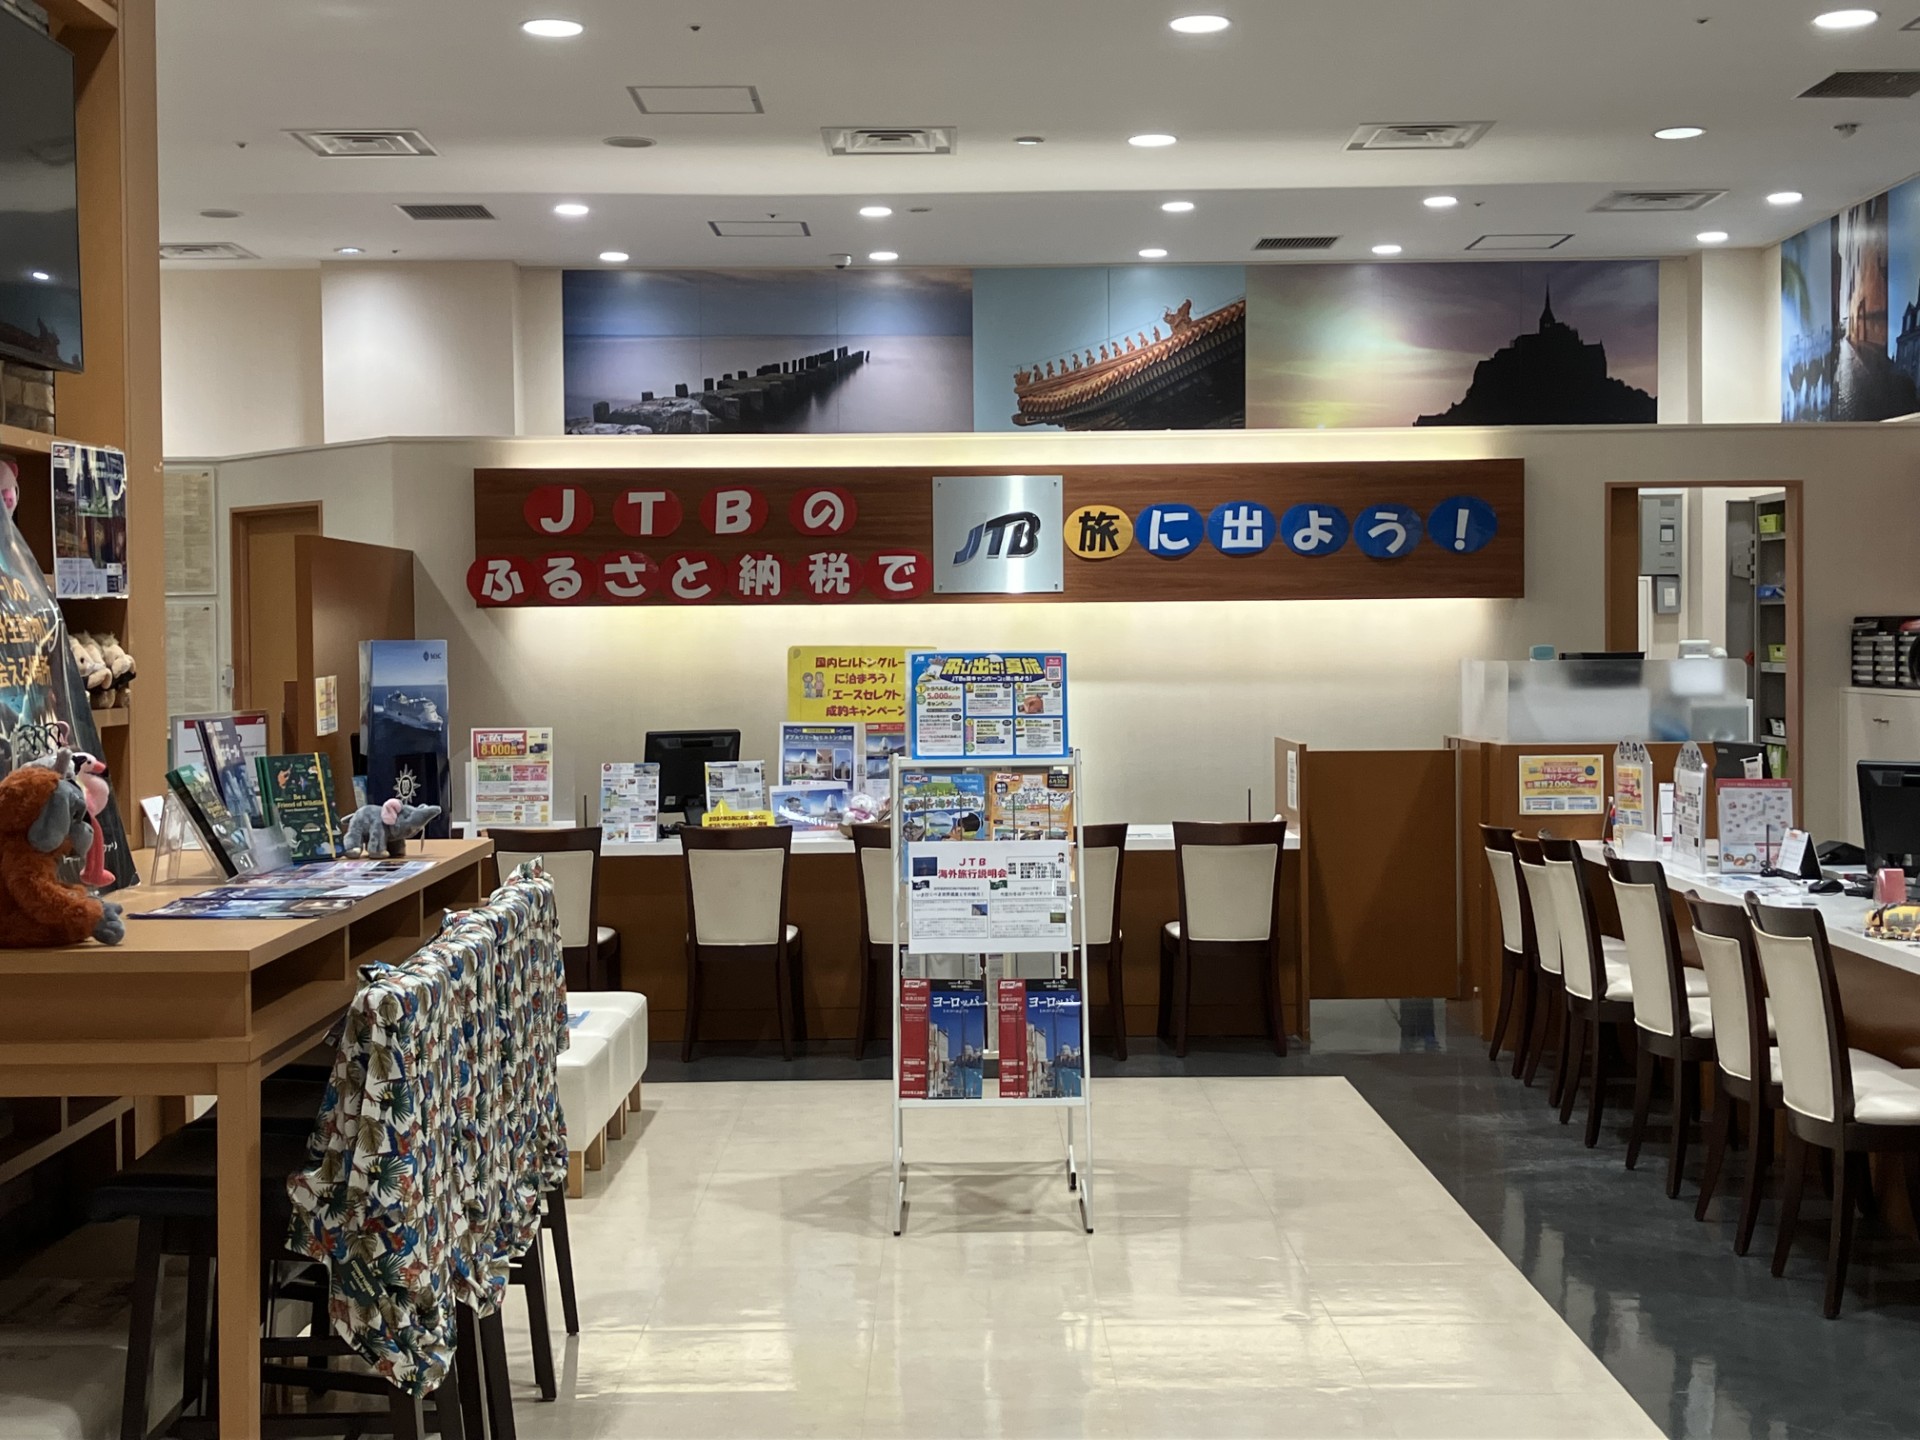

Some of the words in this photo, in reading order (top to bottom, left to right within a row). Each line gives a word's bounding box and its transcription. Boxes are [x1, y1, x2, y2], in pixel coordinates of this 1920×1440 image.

[540, 489, 845, 535] JTBの
[1079, 505, 1470, 554] 旅に出よう!
[953, 511, 1041, 567] JTB
[481, 552, 916, 602] ふるさと納税で
[938, 868, 1008, 879] 海外旅行説明会
[959, 857, 987, 866] JTB
[932, 995, 980, 1008] ヨーロッパ
